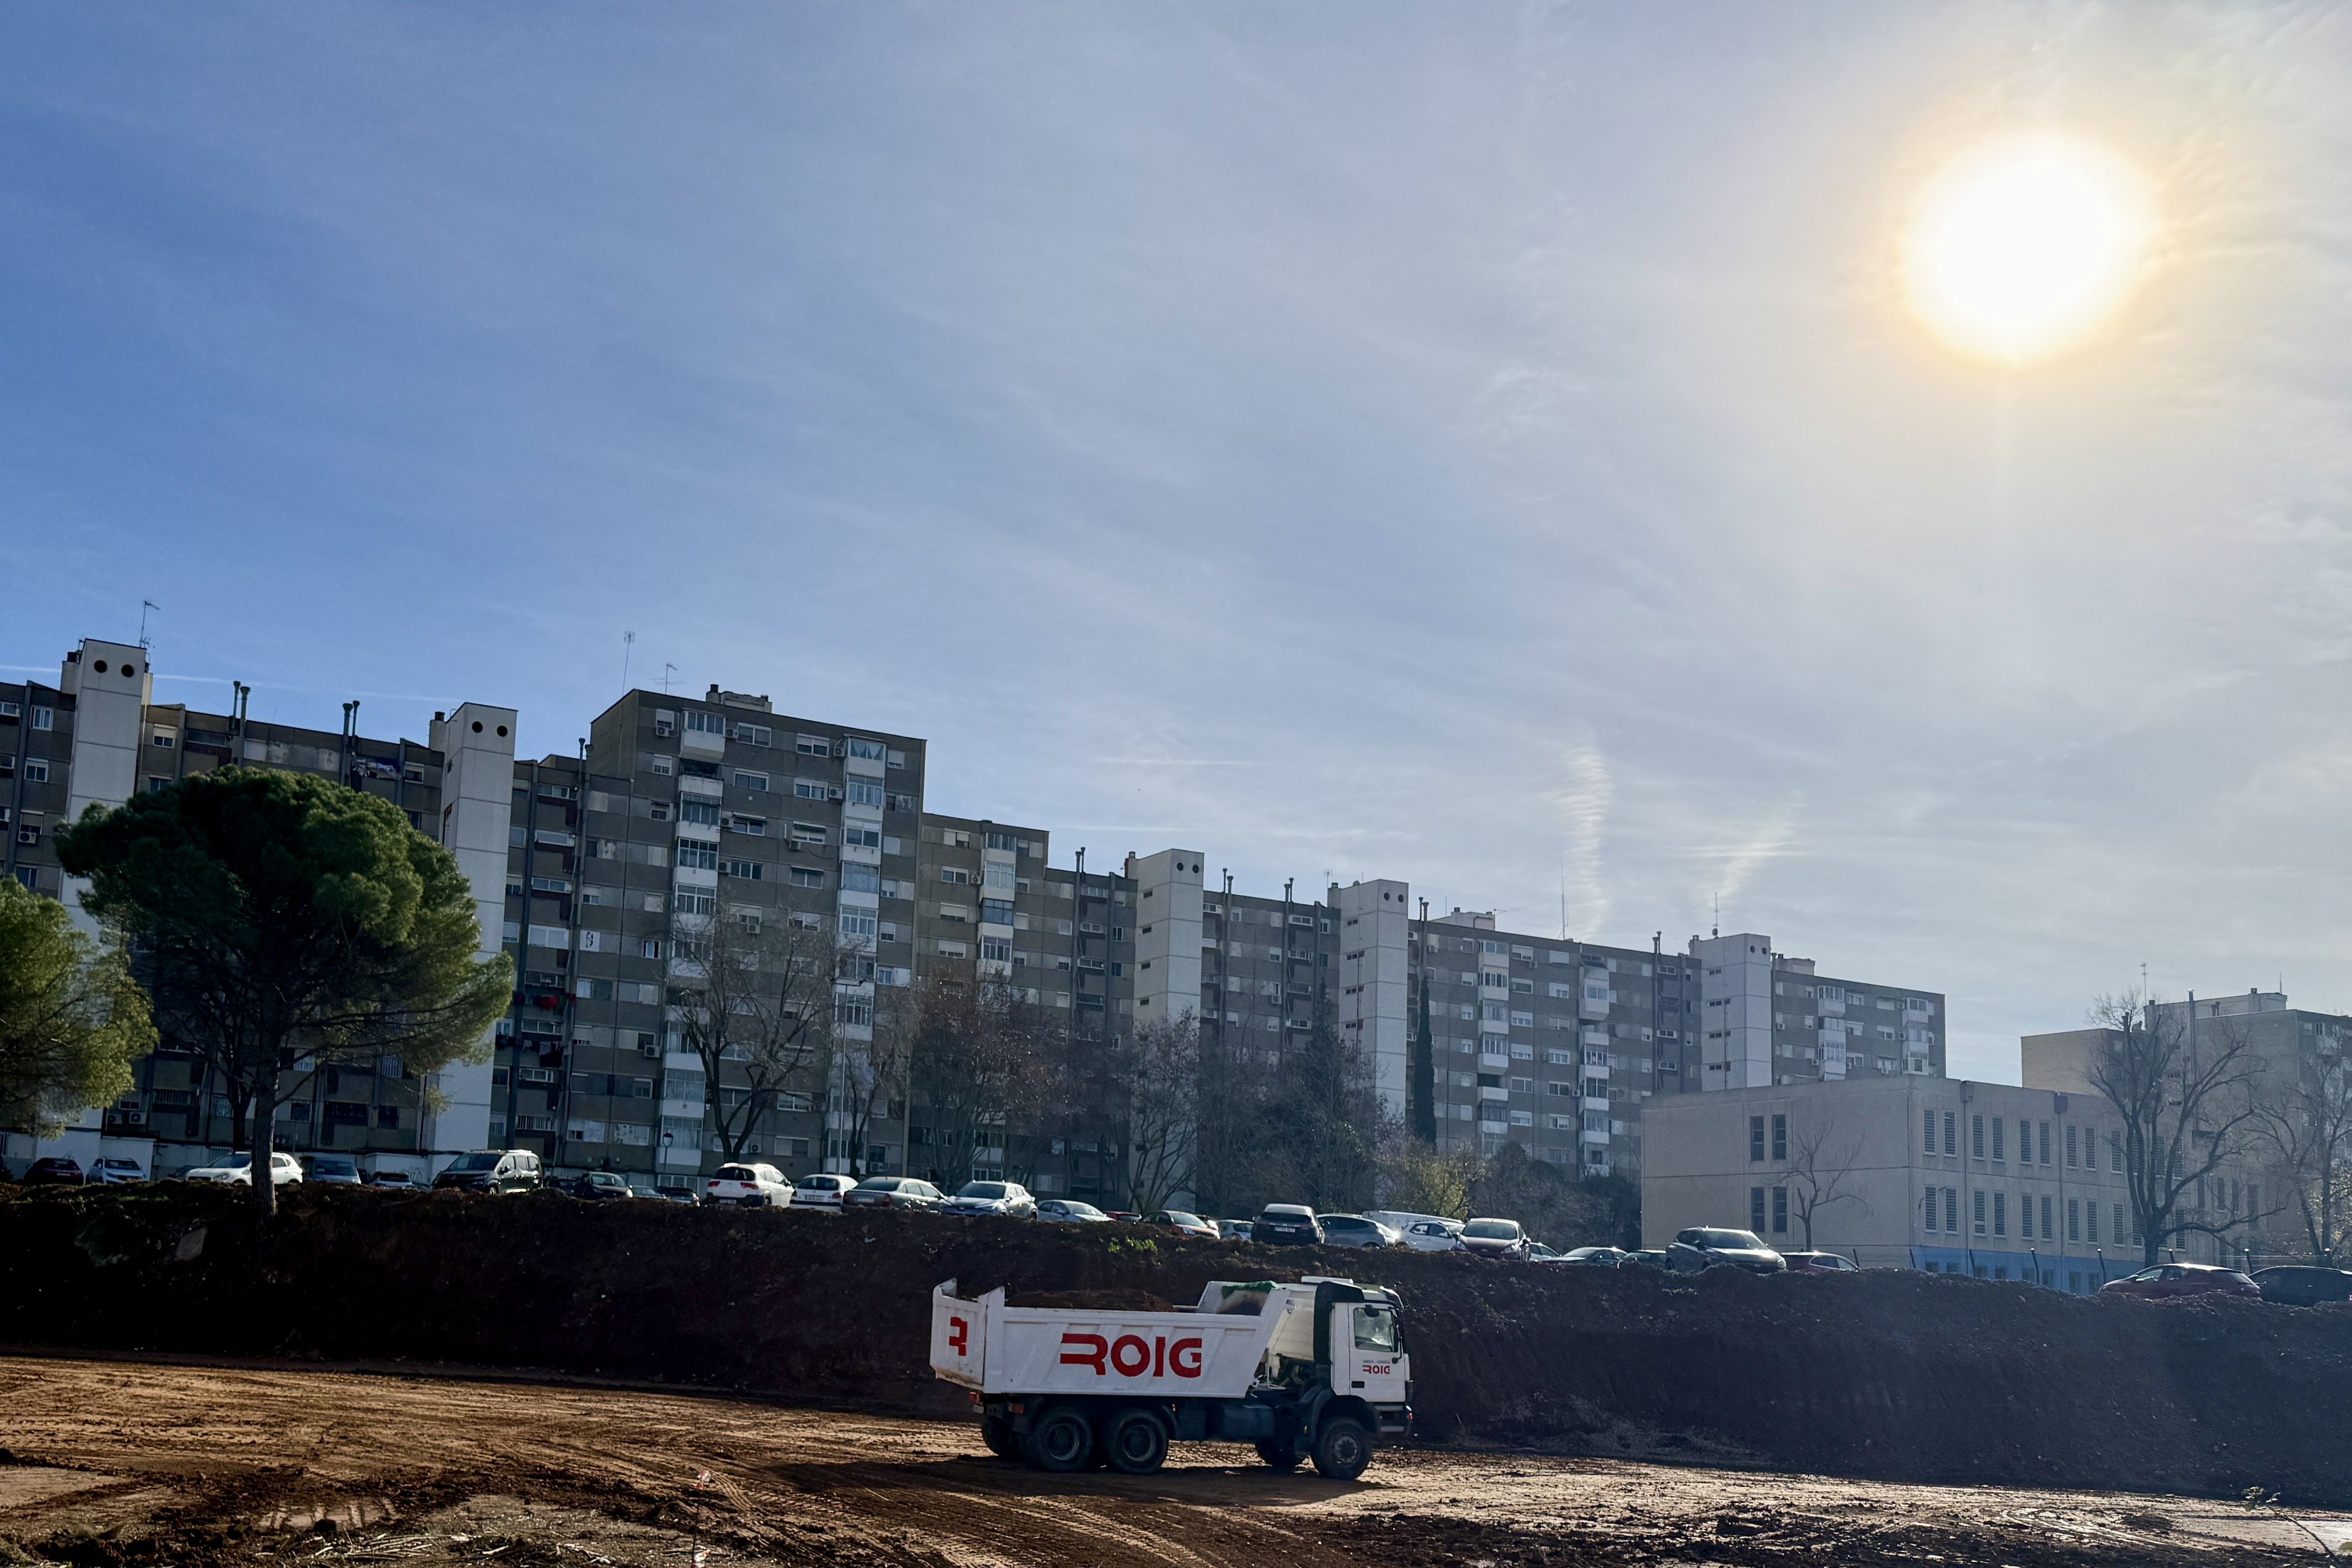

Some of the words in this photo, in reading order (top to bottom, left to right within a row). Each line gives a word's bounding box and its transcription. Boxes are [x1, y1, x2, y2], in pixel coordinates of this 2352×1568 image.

[949, 1316, 968, 1357] R
[1060, 1333, 1202, 1378] ROIG
[1363, 1365, 1390, 1374] ROIG
